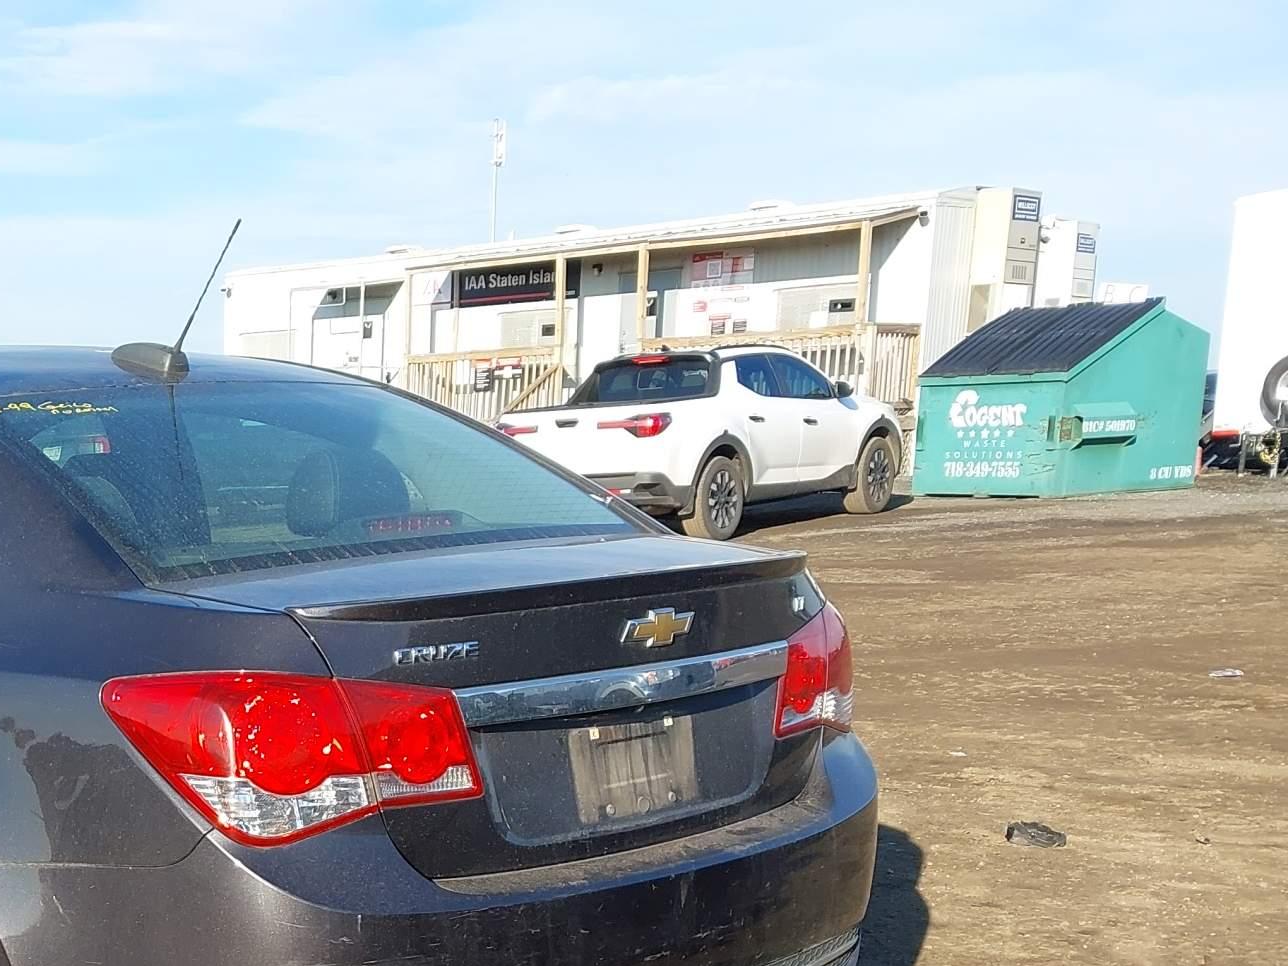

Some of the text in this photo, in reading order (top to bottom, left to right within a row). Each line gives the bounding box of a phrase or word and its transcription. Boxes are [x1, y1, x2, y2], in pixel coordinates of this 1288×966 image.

[465, 274, 486, 291] IAA
[489, 271, 526, 288] Staten
[963, 440, 1006, 448] WASTE
[945, 451, 1022, 459] SOLUTIONS
[944, 461, 1020, 478] 718-349-7555
[394, 641, 479, 666] CRUZE
